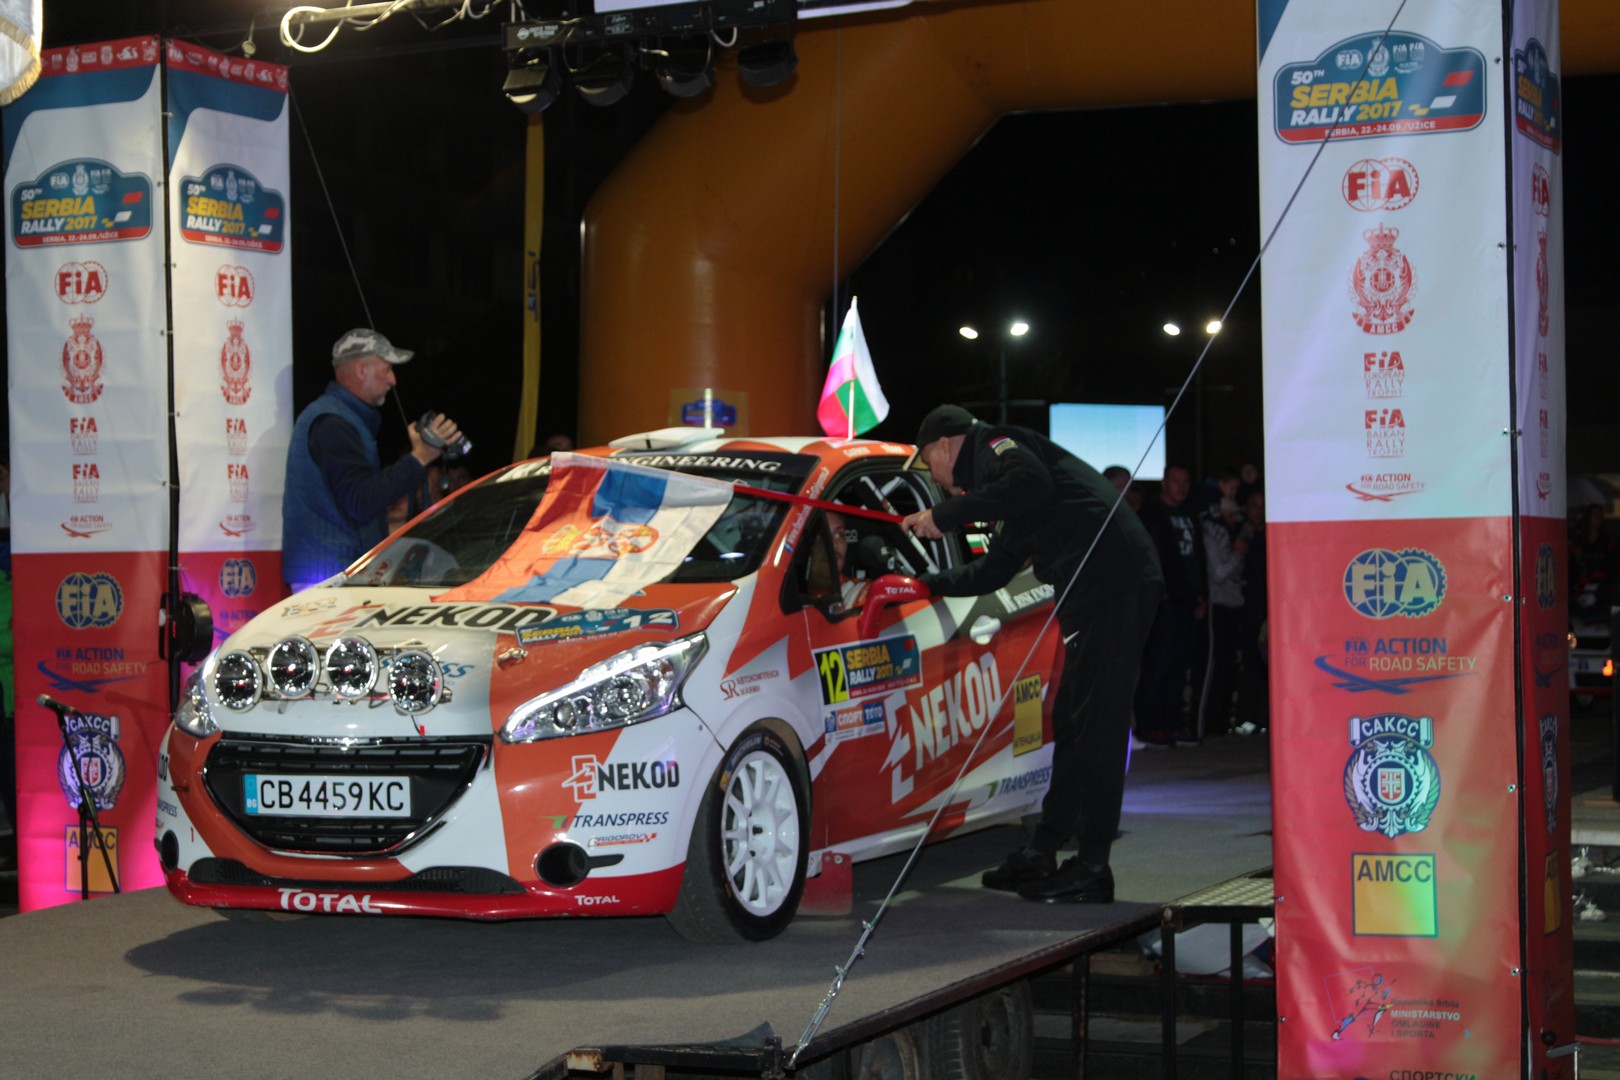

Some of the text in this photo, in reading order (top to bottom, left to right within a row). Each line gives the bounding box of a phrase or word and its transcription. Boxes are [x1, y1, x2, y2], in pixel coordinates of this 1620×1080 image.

[1291, 69, 1325, 86] 50TH
[1290, 77, 1399, 109] SERBIA
[1290, 101, 1402, 127] RALLY 2017
[1324, 127, 1360, 137] SERBIA,
[21, 196, 95, 220] SERBIA
[186, 196, 244, 221] SERBIA
[21, 215, 98, 235] RALLY 2017
[186, 214, 246, 235] RALLY 2017
[1366, 378, 1404, 390] RALLY
[1366, 429, 1405, 439] BALKAN
[1367, 438, 1405, 449] RALLY
[1375, 473, 1411, 482] ACTION
[1396, 481, 1425, 490] SAFETY
[884, 586, 917, 594] TOTAL
[355, 604, 553, 633] NEKOD
[75, 647, 125, 661] ACTION
[1374, 637, 1447, 655] ACTION
[846, 643, 891, 670] SERBIA
[1369, 656, 1413, 671] ROAD
[1417, 655, 1478, 671] SAFETY
[72, 662, 101, 674] ROAD
[102, 661, 147, 674] SAFETY
[849, 667, 876, 686] RALLY
[820, 650, 850, 705] 12
[1015, 679, 1040, 704] AMCC
[910, 651, 1003, 771] NEKOD
[598, 760, 680, 791] NEKOD
[574, 811, 670, 828] TRANSPRESS
[277, 887, 383, 914] TOTAL
[574, 894, 621, 906] TOTAL
[1390, 1009, 1461, 1021] MINISTARSTVO
